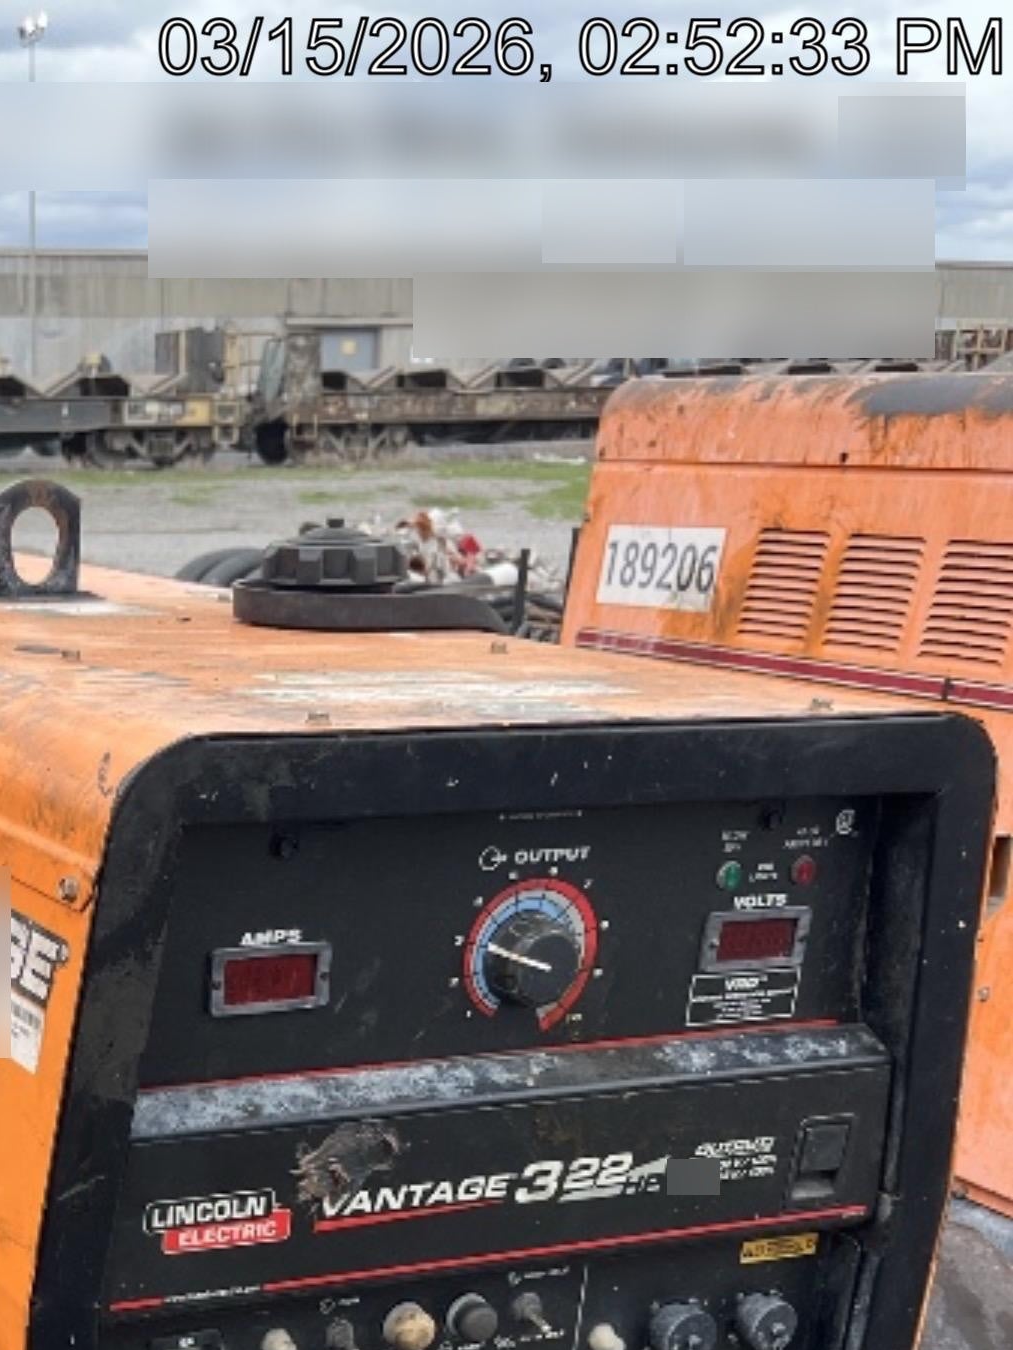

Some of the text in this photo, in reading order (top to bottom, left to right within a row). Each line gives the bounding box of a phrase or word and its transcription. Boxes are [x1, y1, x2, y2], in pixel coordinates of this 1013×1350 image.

[607, 540, 718, 593] 189206
[514, 845, 591, 865] OUTPUT
[733, 893, 787, 909] VOLTS
[240, 929, 302, 945] AMPS
[322, 1173, 518, 1218] VANTAGE
[515, 1152, 633, 1203] 322
[151, 1196, 268, 1228] LINCOLN
[178, 1220, 277, 1247] ELECTRIC
